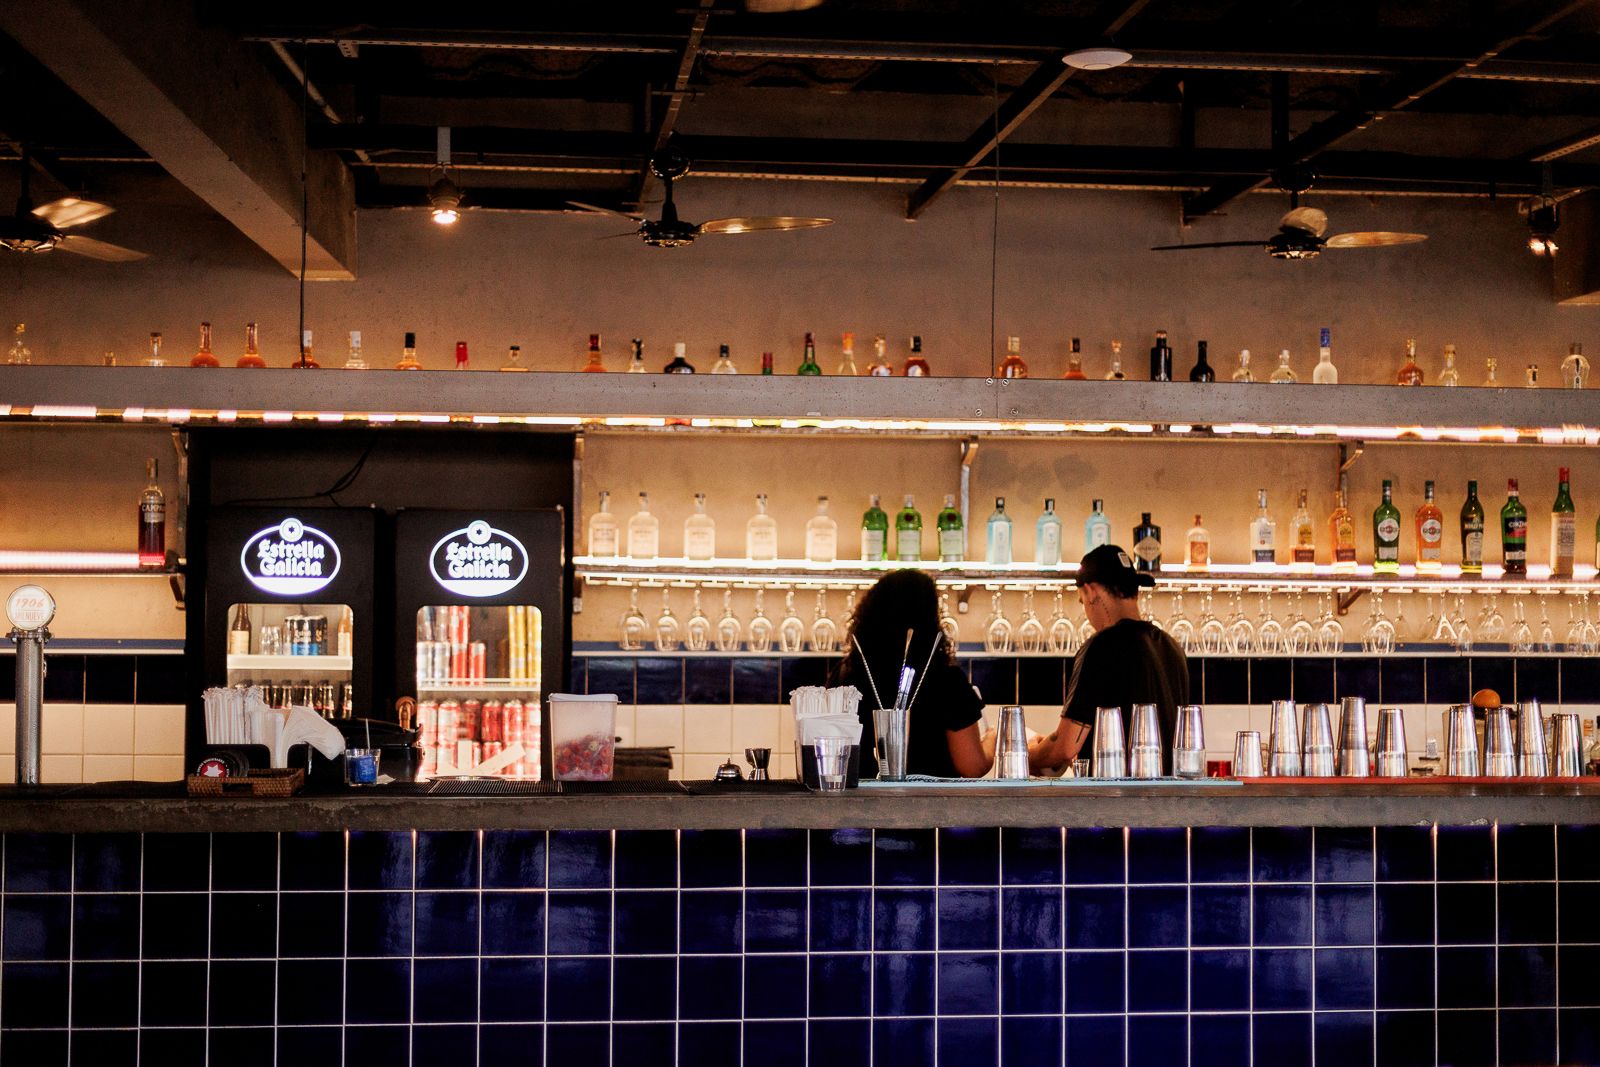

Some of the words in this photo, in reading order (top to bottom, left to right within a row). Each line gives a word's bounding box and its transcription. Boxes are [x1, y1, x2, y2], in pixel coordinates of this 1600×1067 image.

[257, 539, 325, 559] Estrella
[446, 542, 513, 561] Estrella
[260, 557, 322, 576] Galicia
[448, 559, 510, 578] Galicia
[16, 598, 45, 608] 1906
